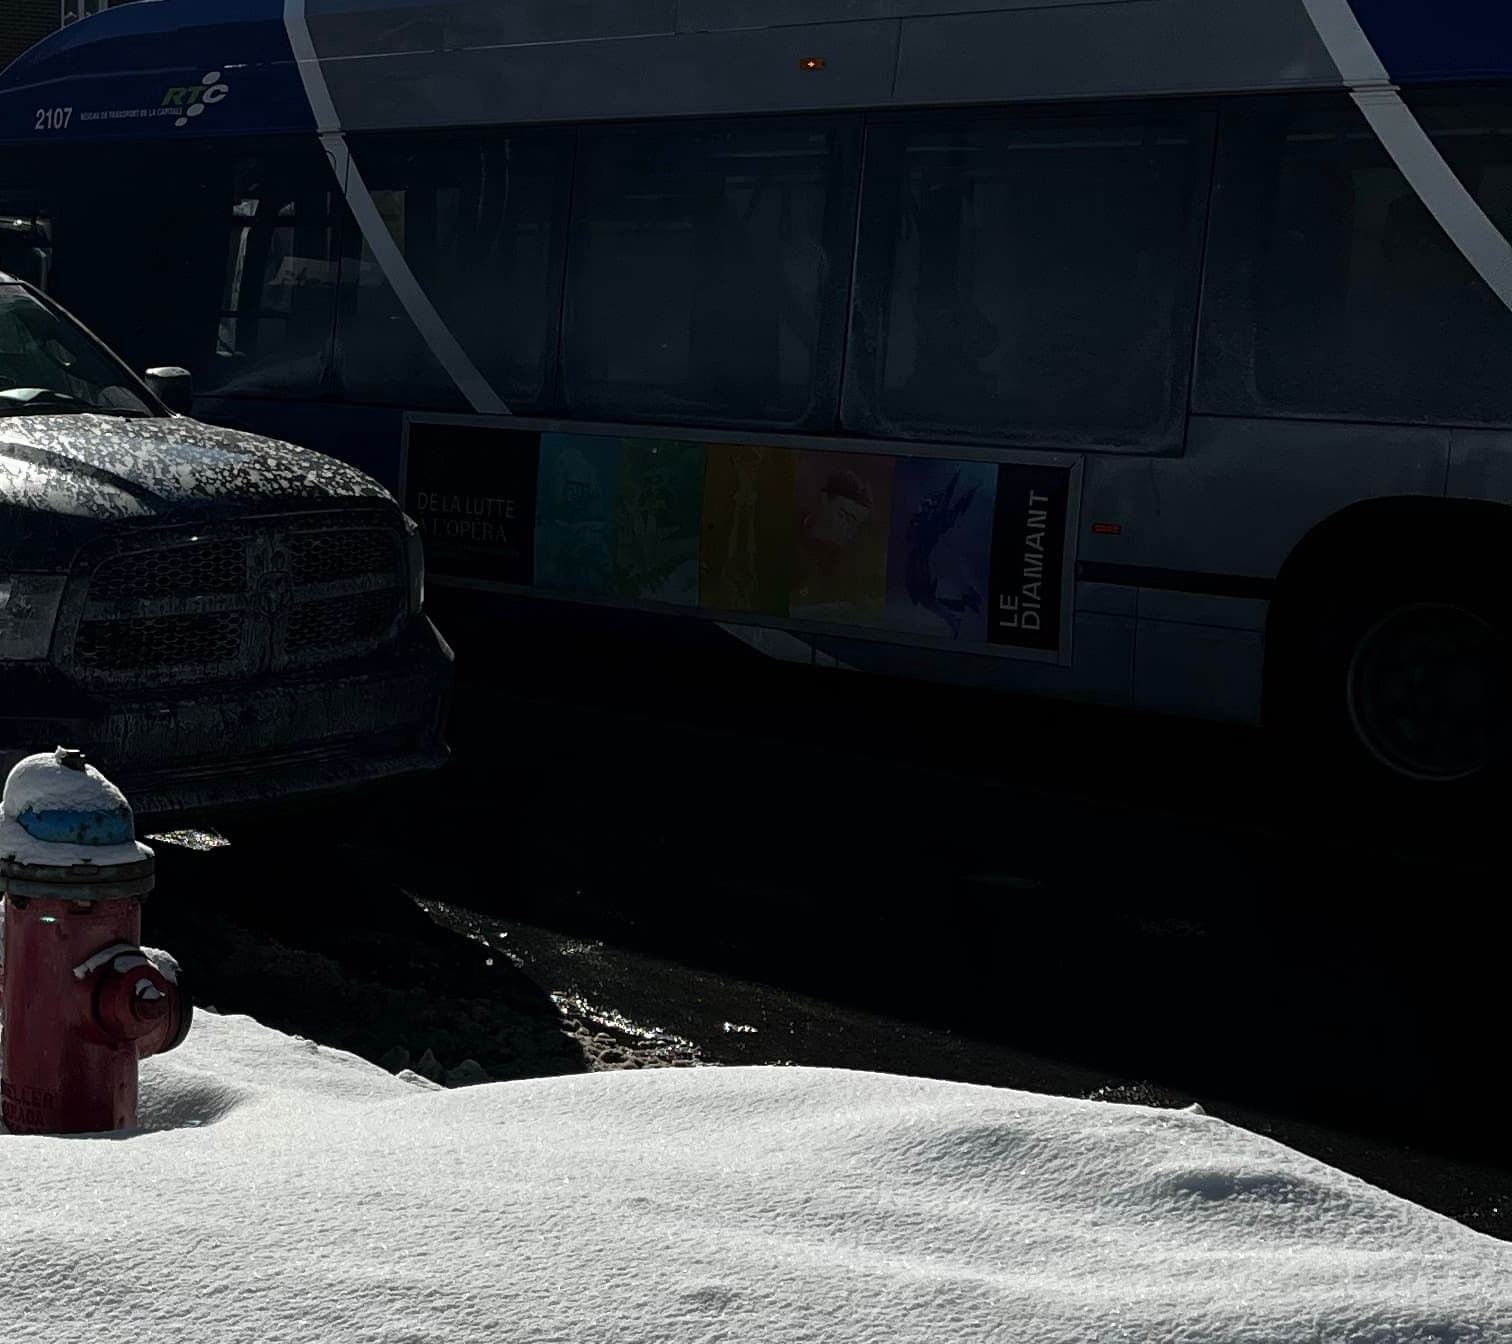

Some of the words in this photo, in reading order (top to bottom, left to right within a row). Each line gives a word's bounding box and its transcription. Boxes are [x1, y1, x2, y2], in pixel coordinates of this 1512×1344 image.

[161, 83, 229, 106] RTC
[34, 107, 73, 130] 2107
[416, 491, 439, 512] DE
[442, 495, 462, 514] LA
[465, 495, 518, 520] LUTTE
[1021, 488, 1049, 631] DIAMANT
[999, 593, 1019, 629] LE
